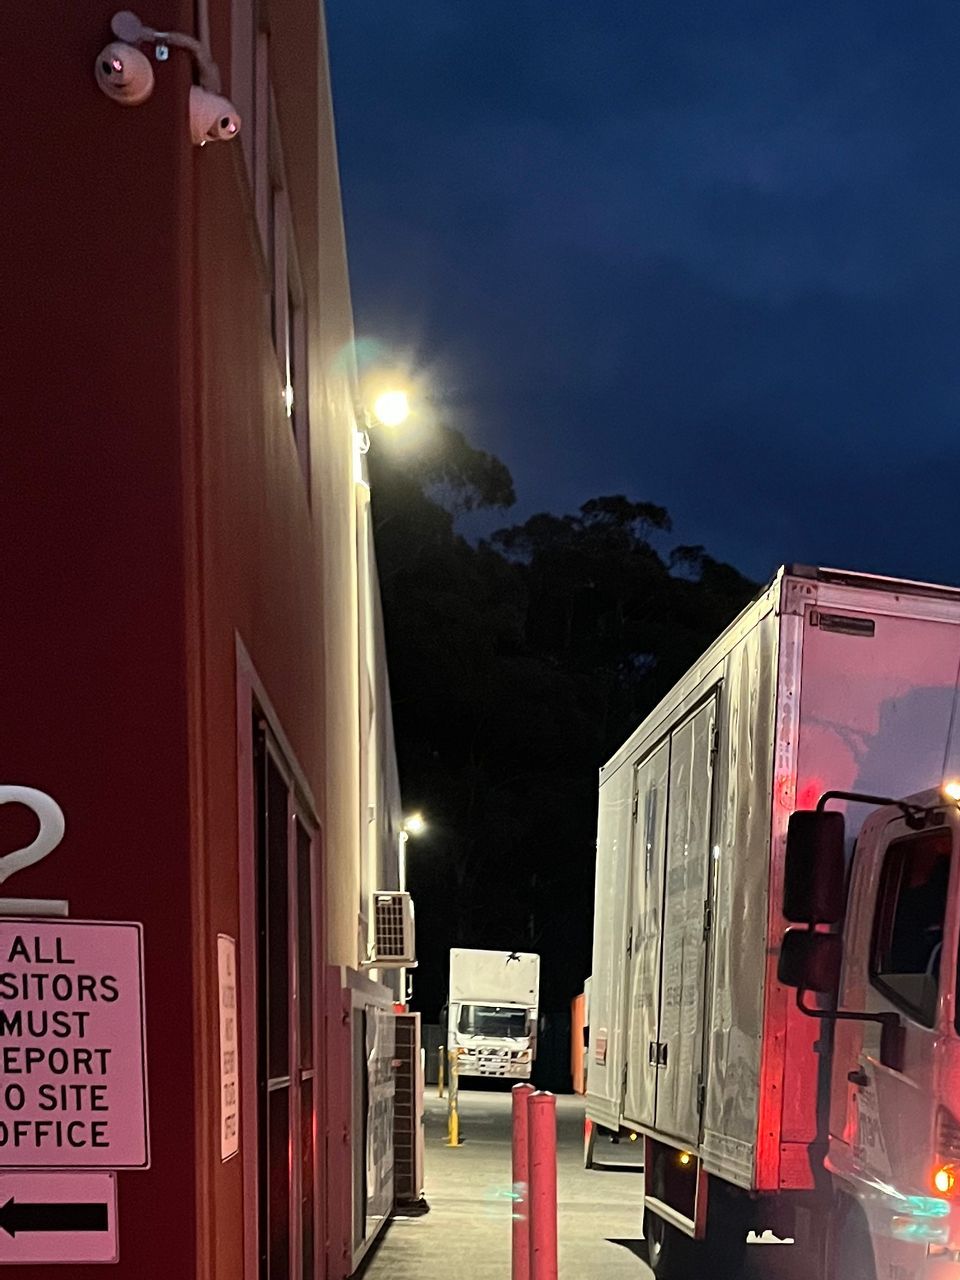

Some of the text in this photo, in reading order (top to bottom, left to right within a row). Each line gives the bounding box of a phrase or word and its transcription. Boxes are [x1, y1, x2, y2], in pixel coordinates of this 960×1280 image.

[7, 935, 75, 964] ALL
[0, 972, 119, 1002] SITORS
[0, 1009, 90, 1038] MUST
[3, 1047, 112, 1074] EPORT
[4, 1083, 109, 1111] O SITE
